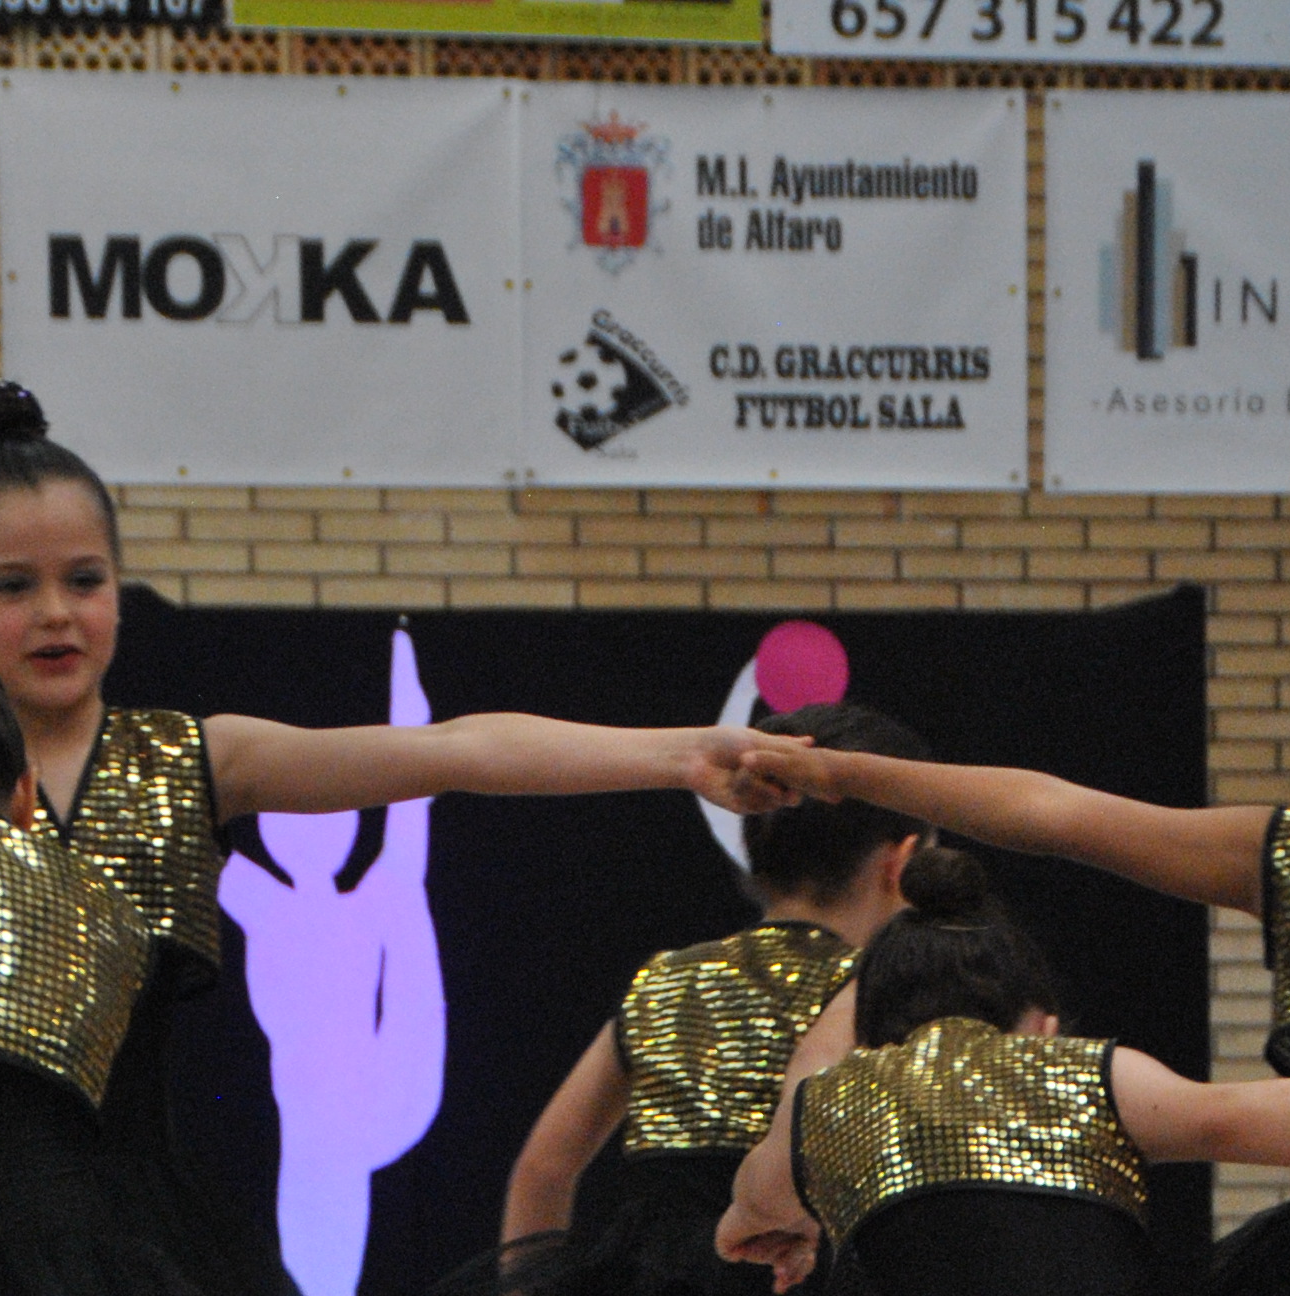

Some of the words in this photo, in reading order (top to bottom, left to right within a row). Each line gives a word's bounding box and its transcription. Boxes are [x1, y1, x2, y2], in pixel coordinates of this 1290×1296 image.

[971, 0, 1086, 42] 315
[1108, 0, 1224, 45] 422
[697, 154, 758, 197] M.I.
[771, 154, 978, 205] Ayuntamiento
[698, 207, 733, 251] de
[746, 208, 842, 251] Alfaro
[709, 343, 767, 380] C.D.
[774, 344, 990, 380] GRACCURRIS
[735, 394, 871, 429] FUTBOL
[876, 394, 966, 429] SALA
